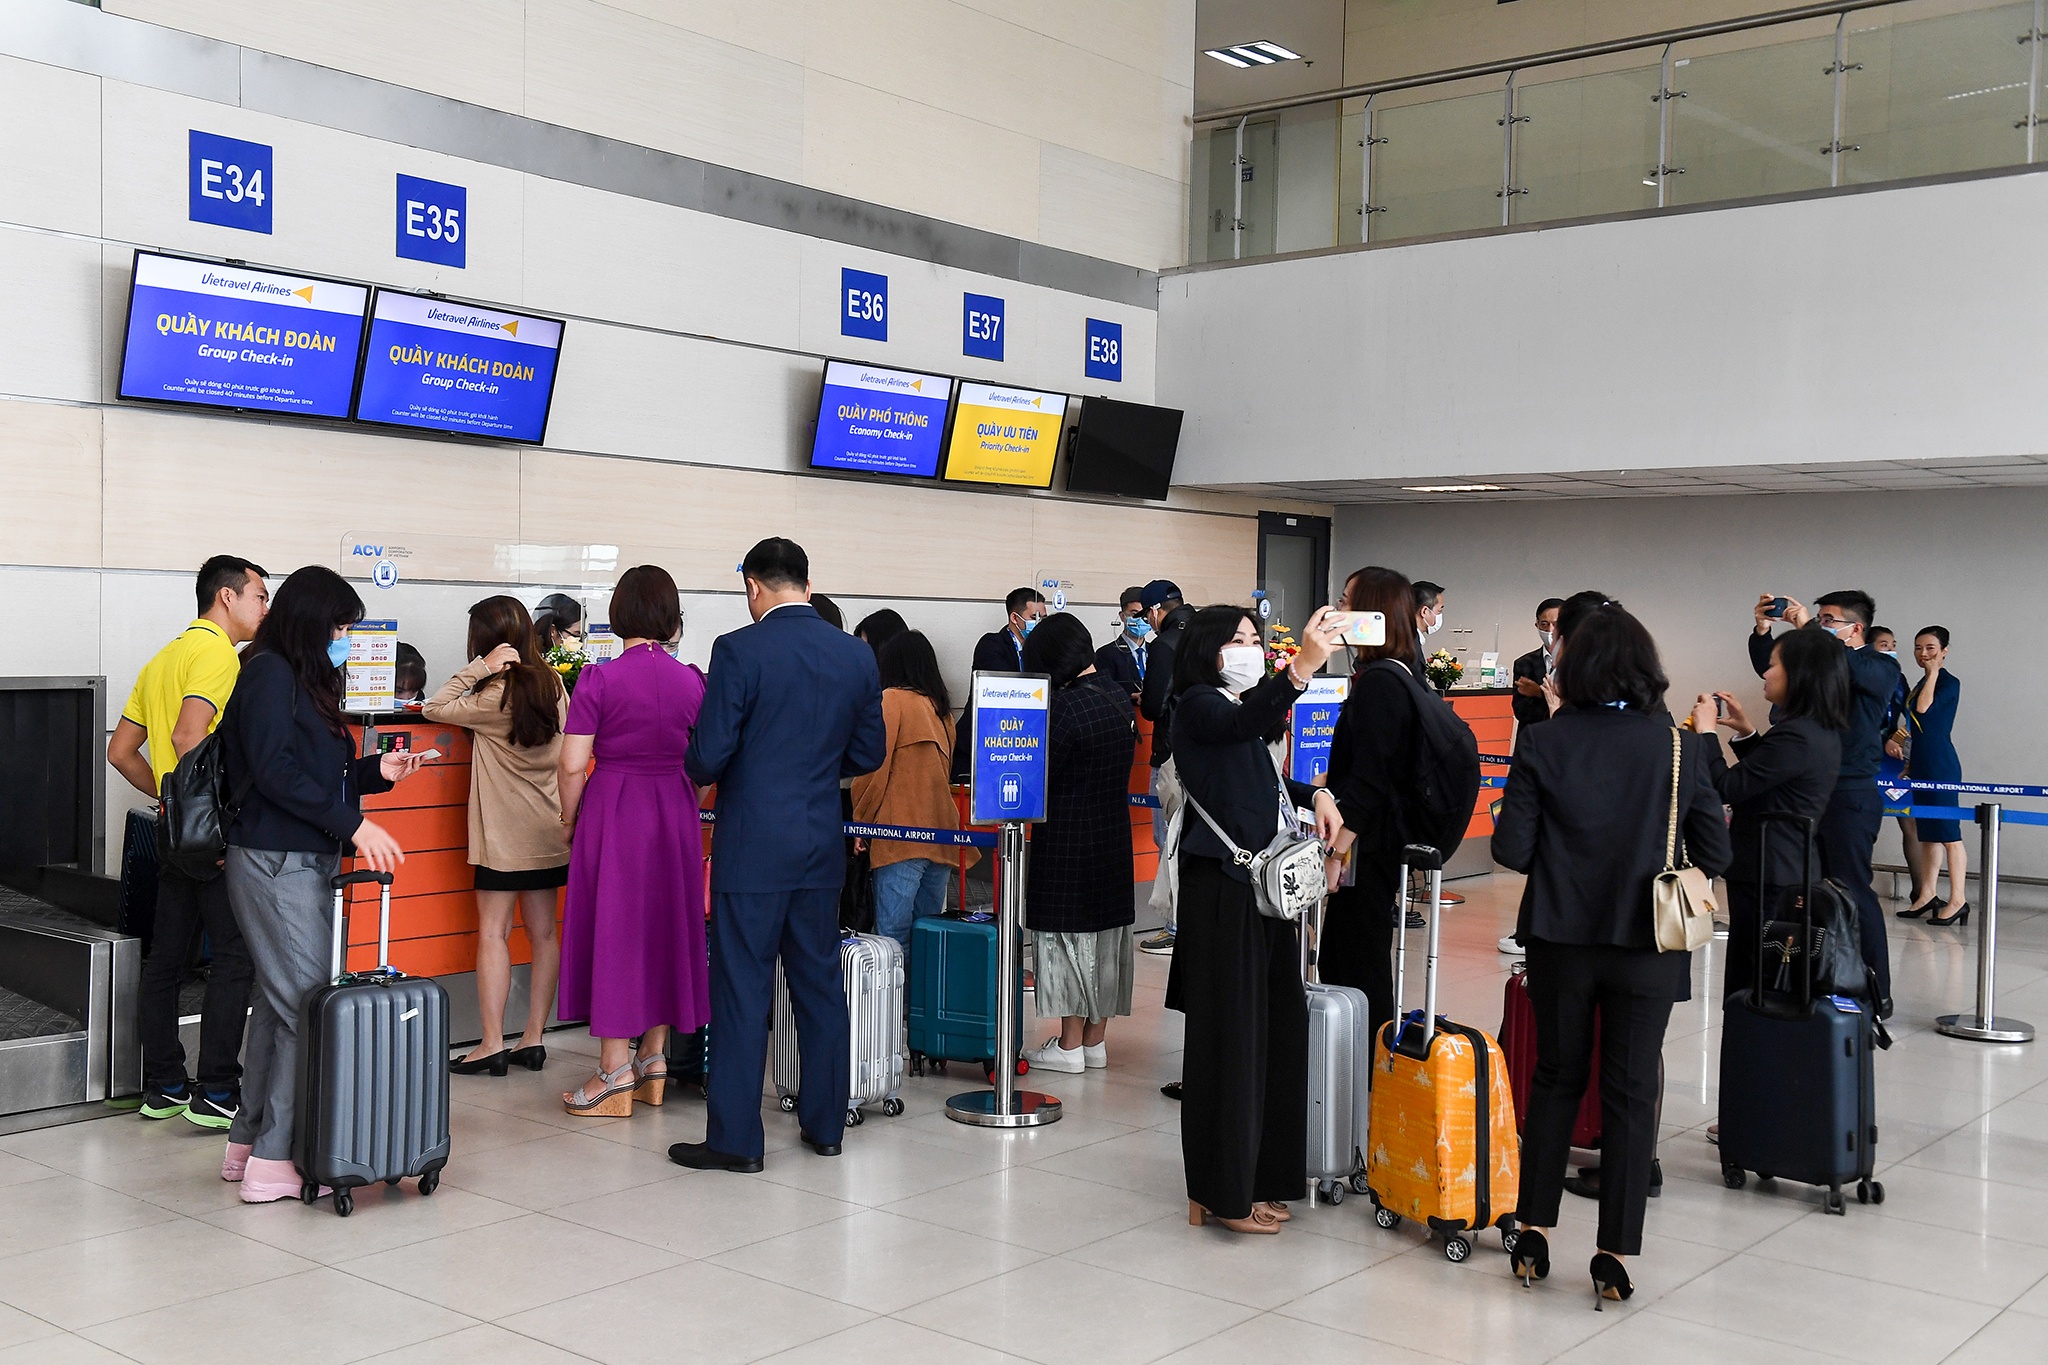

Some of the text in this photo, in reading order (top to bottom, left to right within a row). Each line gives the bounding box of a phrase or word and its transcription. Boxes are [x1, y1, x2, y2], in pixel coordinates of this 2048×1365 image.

[201, 159, 264, 207] E34
[406, 200, 460, 243] E35
[202, 273, 291, 297] Vietravel Airlines
[848, 289, 884, 322] E36
[428, 308, 500, 330] Vietravel Airlines
[969, 311, 1000, 341] E37
[156, 312, 336, 352] QUẦY KHÁCH ĐOÀN
[198, 344, 294, 367] Group Check-in
[1090, 336, 1118, 365] E38
[389, 344, 534, 381] QUẦY KHÁCH ĐOÀN
[422, 373, 499, 394] Group Check-in
[861, 373, 910, 388] Vietravel Airlines
[163, 384, 185, 392] Counter
[206, 388, 224, 396] closed
[234, 391, 255, 400] minutes
[256, 393, 274, 401] before
[275, 395, 300, 404] Departure
[989, 392, 1030, 405] Vietravel Airlines
[838, 403, 928, 428] QUẦY PHỐ THÔNG
[849, 425, 913, 441] Economy Check-in
[977, 421, 1038, 440] QUẦY ƯU TIÊN
[980, 441, 1030, 453] Priority Check-in
[353, 545, 384, 556] ACV
[1042, 580, 1058, 588] ACV
[982, 687, 1031, 699] Vietravel Airlines
[1000, 716, 1024, 733] QUẦY
[1312, 709, 1330, 723] QUẦY
[1302, 724, 1334, 736] PHỐ THÔN
[984, 734, 1038, 748] KHÁCH ĐOÀN
[990, 753, 1007, 764] Group
[1936, 783, 1990, 793] INTERNATIONAL
[1993, 786, 2024, 794] AIRPORT
[849, 826, 902, 838] INTERNATIONAL
[905, 830, 935, 841] AIRPORT
[953, 835, 972, 843] N.I.A
